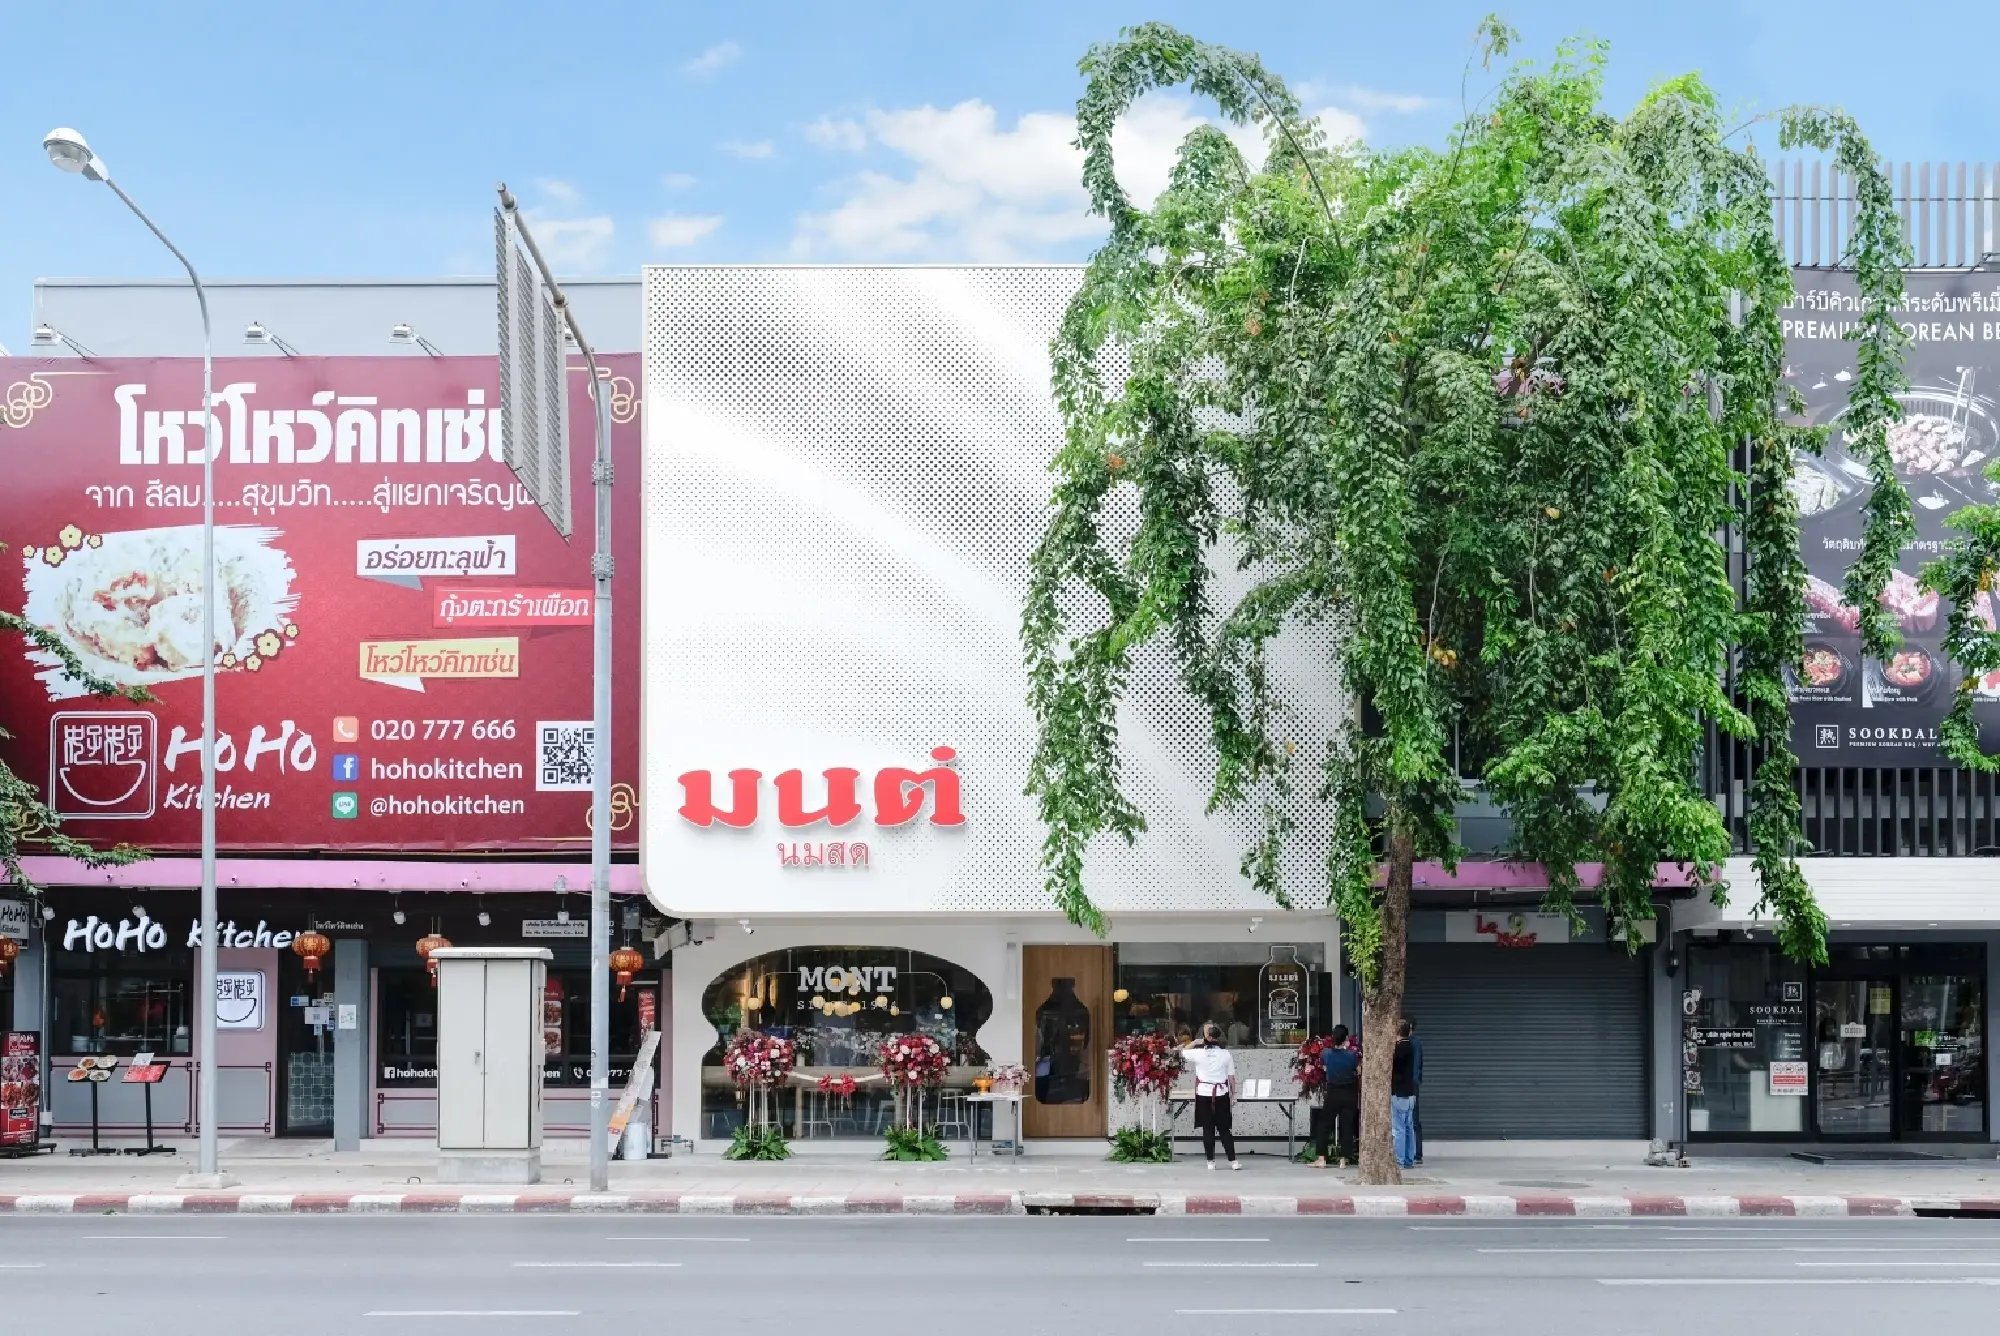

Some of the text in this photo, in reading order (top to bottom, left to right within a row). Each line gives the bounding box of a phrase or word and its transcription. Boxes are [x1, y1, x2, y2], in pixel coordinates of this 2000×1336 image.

[1888, 321, 1974, 342] OREAN
[114, 383, 504, 465] โหว์โหว์คิทเช่
[85, 486, 134, 508] จาก
[365, 539, 507, 575] อร่อยทะลุฟ้า
[440, 594, 589, 623] กุ้งตะกร้าเผือก
[365, 645, 515, 673] โหว์โหว์คิทเช่น
[371, 719, 516, 741] 020 777 666
[371, 757, 524, 780] hohokitchen
[163, 783, 271, 810] Kitchen
[370, 795, 525, 817] @hohokitchen
[777, 842, 871, 868] นมสด
[186, 917, 302, 949] Kitche
[797, 966, 897, 992] MONT
[1270, 1022, 1298, 1030] MONT
